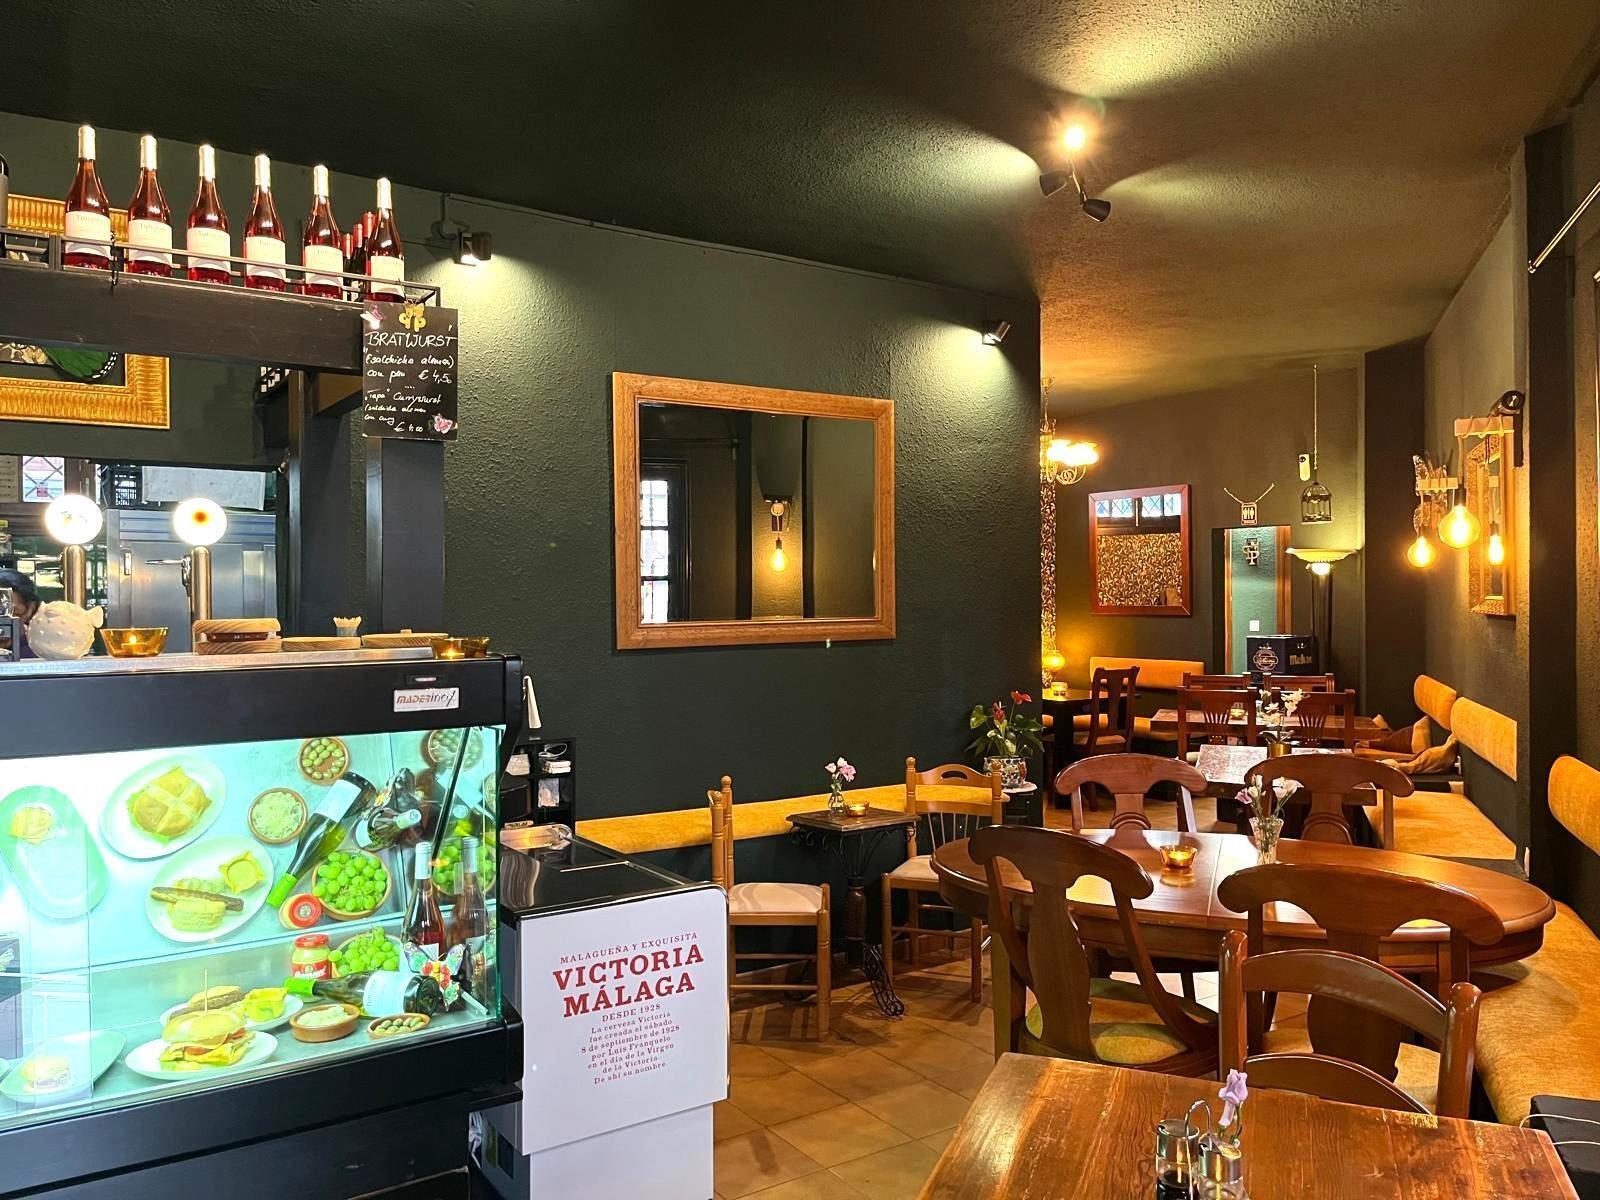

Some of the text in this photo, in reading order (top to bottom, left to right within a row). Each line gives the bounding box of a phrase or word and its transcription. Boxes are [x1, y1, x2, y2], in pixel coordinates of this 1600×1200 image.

[419, 370, 429, 379] €
[560, 945, 629, 964] MALAGUEÑA
[641, 932, 697, 949] EXQUISITA
[553, 944, 703, 990] VICTORIA
[563, 973, 695, 1017] MÁLAGA
[602, 1004, 661, 1022] DESDE 1928
[604, 1021, 636, 1031] cerveza
[638, 1013, 670, 1023] Victoria
[601, 1034, 648, 1049] septiembre
[662, 1025, 680, 1034] 1928
[605, 1028, 633, 1039] creada
[644, 1019, 673, 1031] sábado
[592, 1037, 671, 1061] por Luis Franquelo
[610, 1056, 623, 1064] día
[647, 1044, 674, 1054] Virgen
[608, 1073, 621, 1081] ahí
